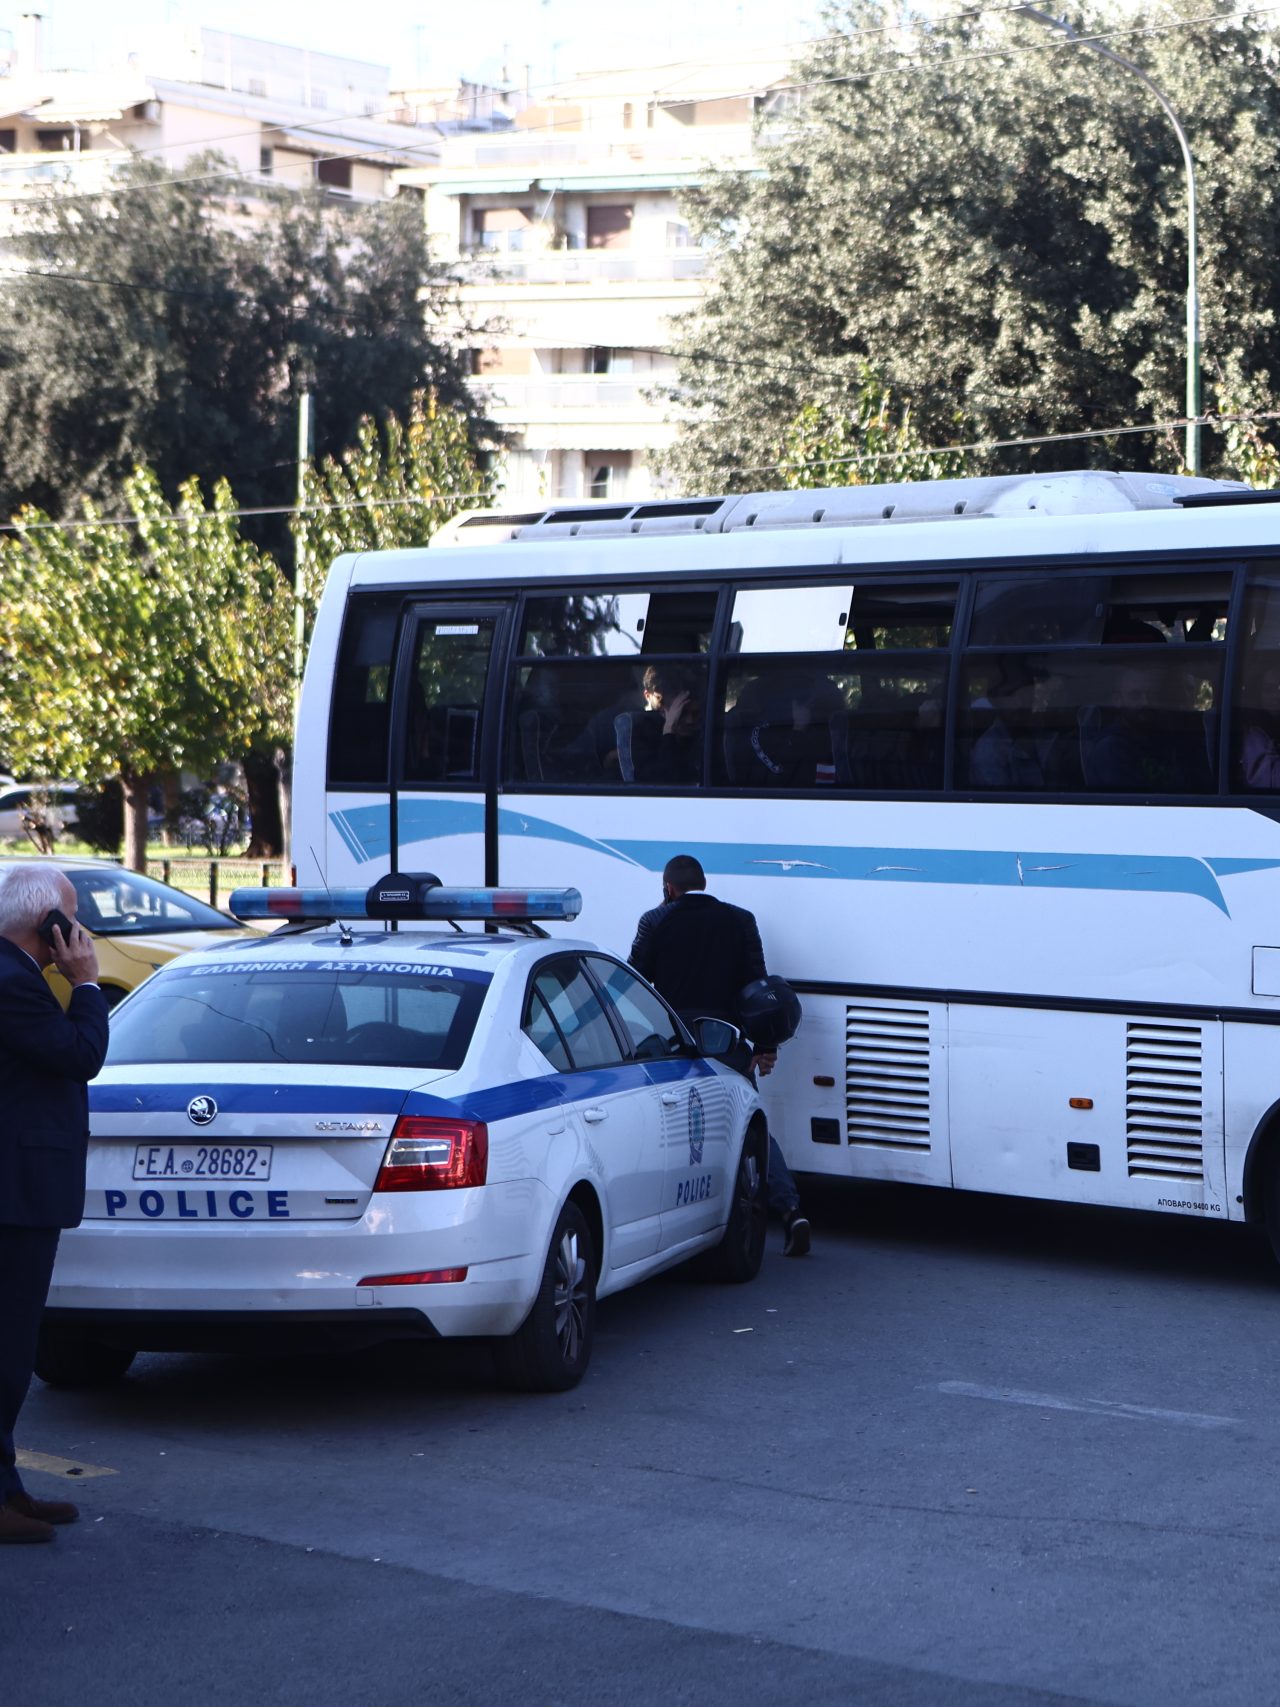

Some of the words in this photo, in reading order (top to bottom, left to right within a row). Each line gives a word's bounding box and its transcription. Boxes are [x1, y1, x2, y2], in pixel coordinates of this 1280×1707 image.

[191, 961, 308, 976] ΕΛΛΗΝΙΚΗ
[319, 962, 454, 977] ΑΣΤΥΝΟΜΙΑ
[315, 1121, 382, 1132] OCTAVIA
[195, 1148, 258, 1176] 28682
[676, 1174, 711, 1206] POLICE
[104, 1190, 290, 1217] POLICE
[1210, 1204, 1221, 1212] KG
